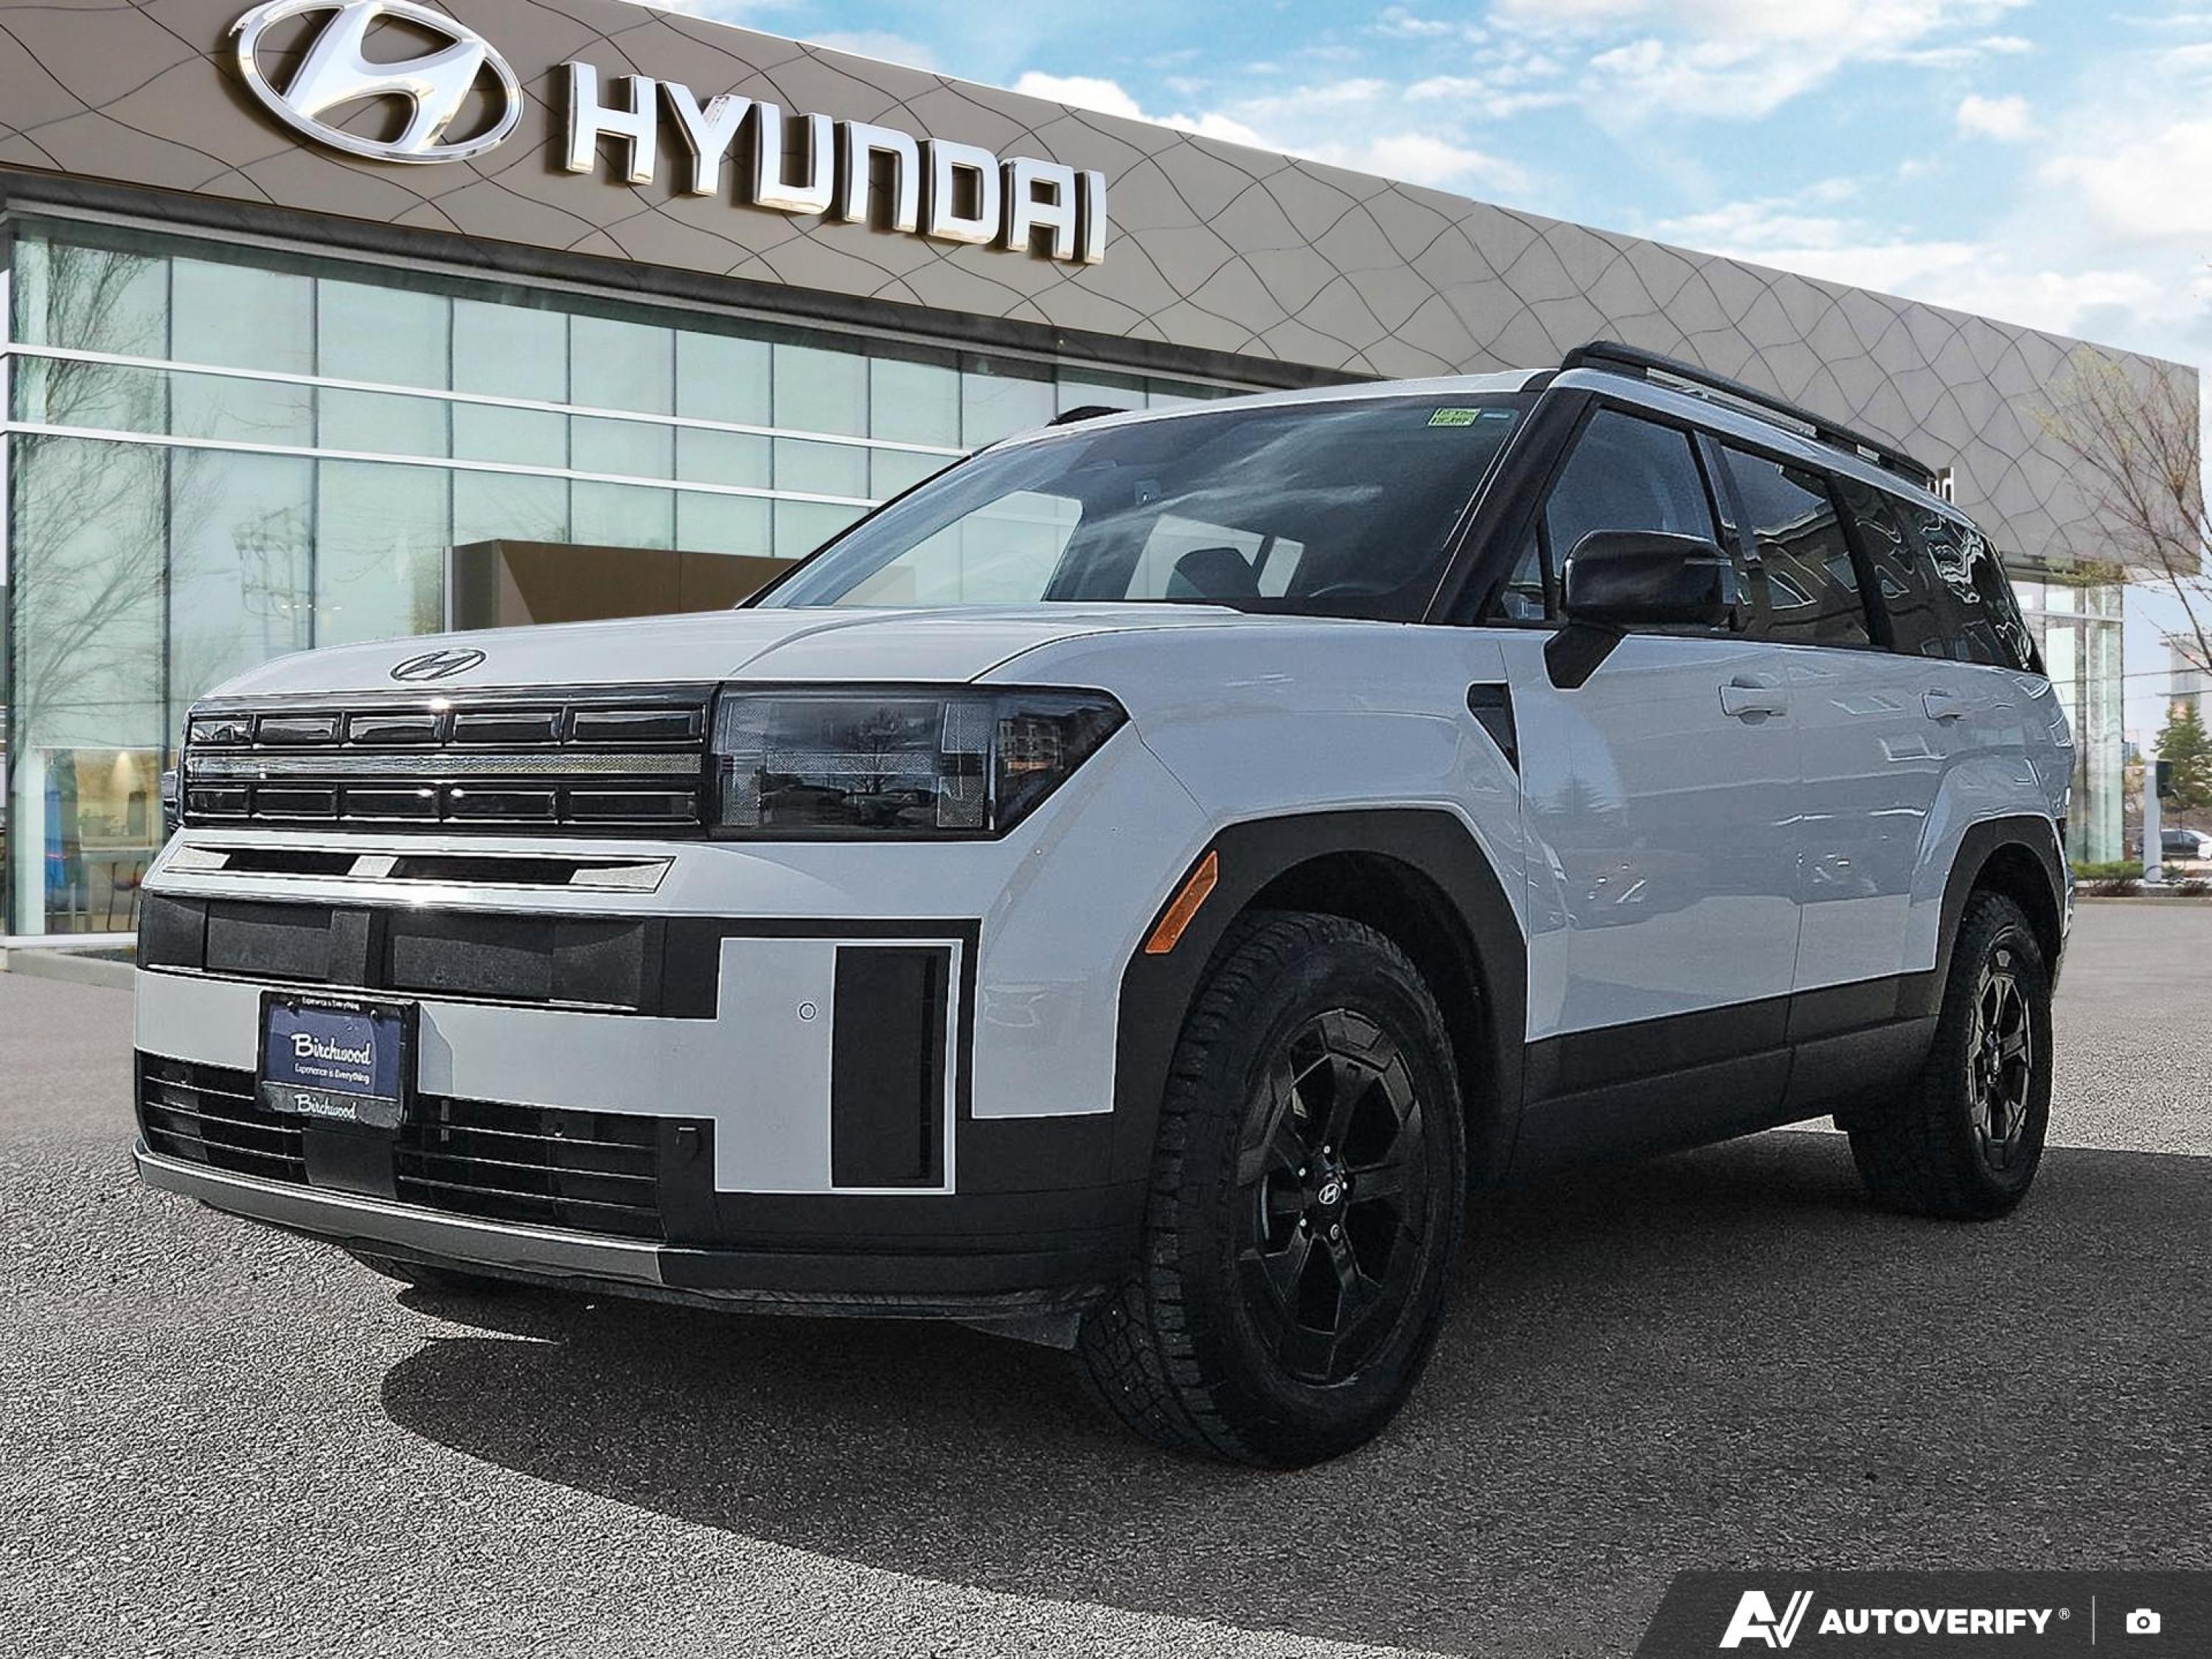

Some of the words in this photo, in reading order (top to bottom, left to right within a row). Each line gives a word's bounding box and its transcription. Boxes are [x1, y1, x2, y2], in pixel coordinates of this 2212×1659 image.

[559, 61, 1107, 265] HYUNDAI
[291, 1033, 372, 1065] Birchwood
[294, 1093, 356, 1120] Birchwood
